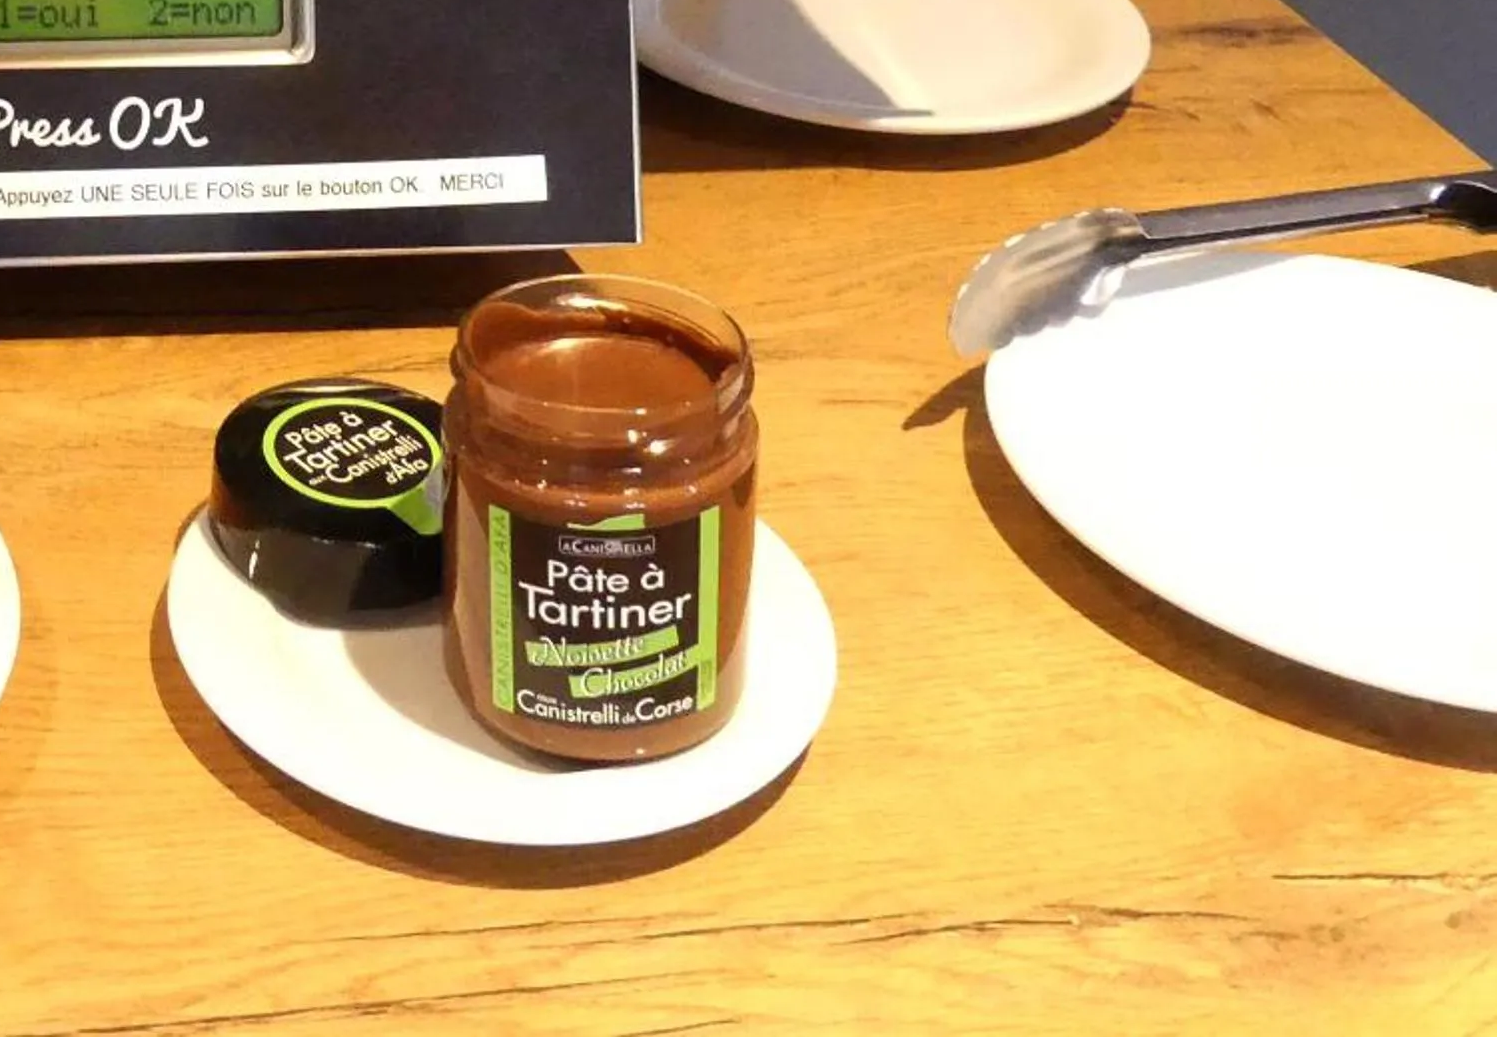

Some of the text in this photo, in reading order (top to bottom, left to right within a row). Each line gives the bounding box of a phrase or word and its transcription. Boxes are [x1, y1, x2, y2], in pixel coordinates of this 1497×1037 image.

[108, 97, 209, 151] OK
[81, 185, 123, 203] UNE
[131, 183, 197, 202] SEULE
[207, 181, 255, 199] FOIS
[261, 181, 289, 198] sur
[297, 180, 313, 196] le
[320, 178, 383, 196] bouton
[439, 173, 505, 192] MERCI
[283, 420, 399, 474] Tartiner
[284, 422, 342, 449] Pâte
[547, 559, 665, 593] Pâte à
[518, 580, 692, 629] Tartiner
[530, 635, 645, 667] Noisette
[580, 652, 689, 698] Chocolat
[516, 689, 620, 725] Canistrelli
[635, 695, 694, 722] Corse
